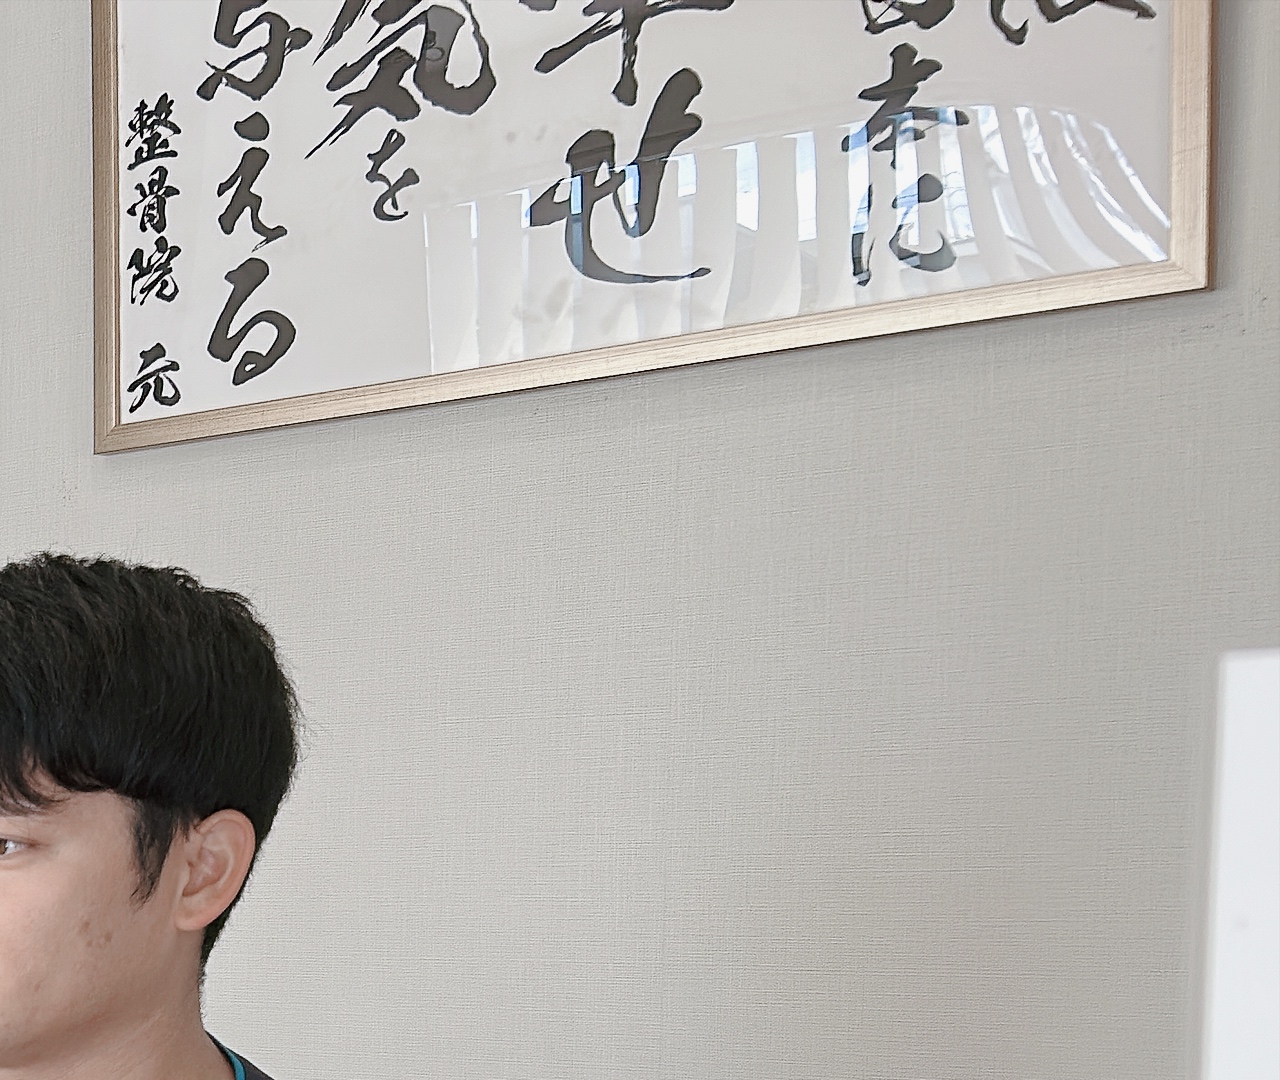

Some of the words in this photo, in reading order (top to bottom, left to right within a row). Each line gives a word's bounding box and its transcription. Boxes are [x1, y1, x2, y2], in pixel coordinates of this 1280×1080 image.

[125, 93, 182, 305] 整骨院
[127, 343, 182, 413] 元
